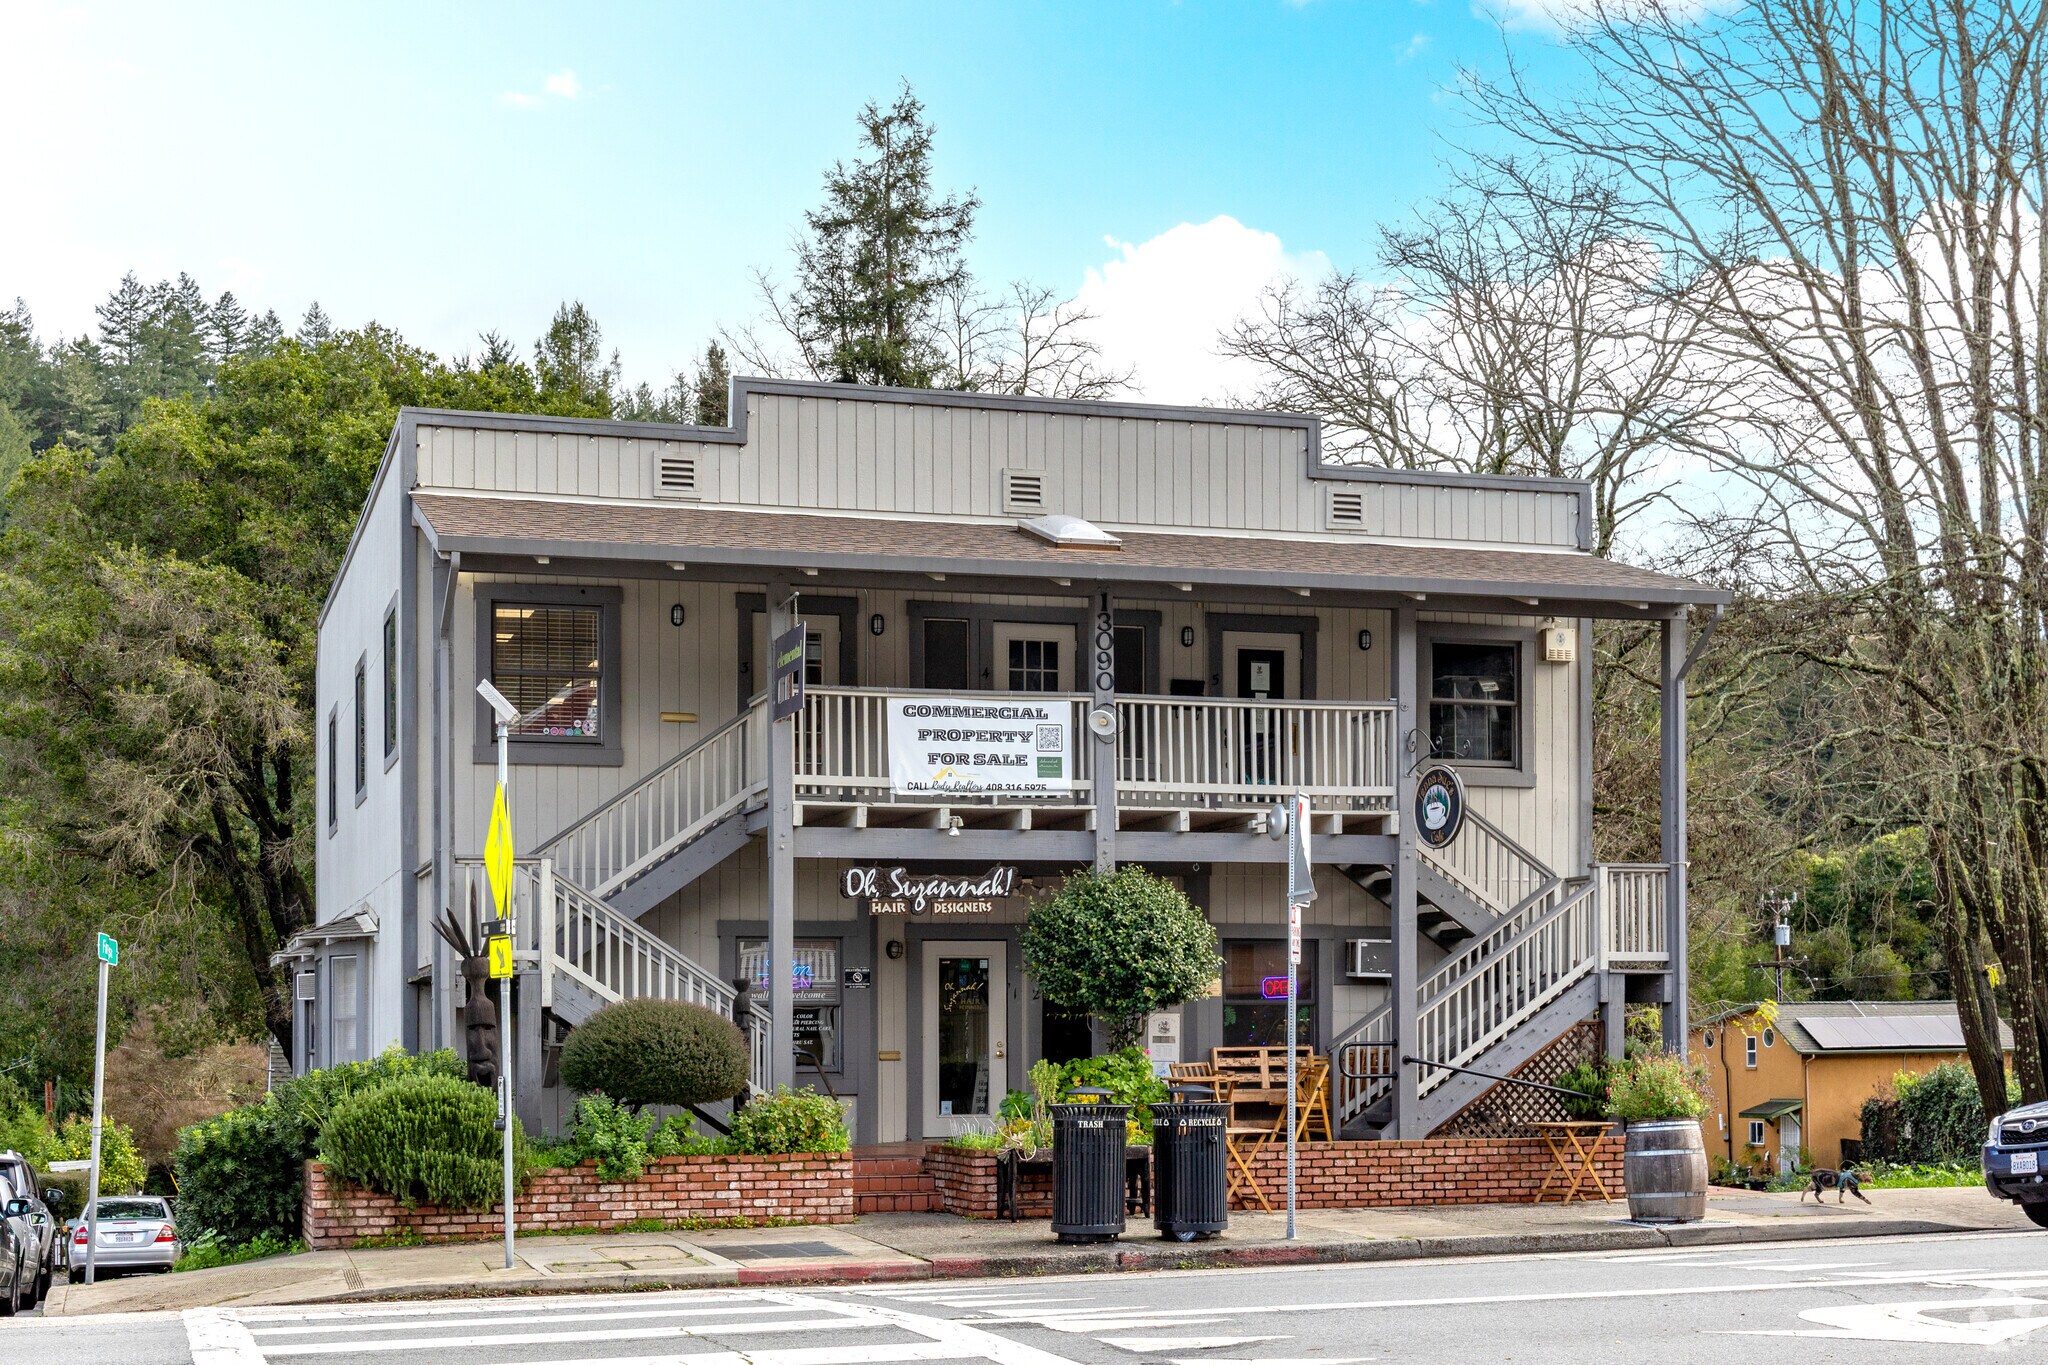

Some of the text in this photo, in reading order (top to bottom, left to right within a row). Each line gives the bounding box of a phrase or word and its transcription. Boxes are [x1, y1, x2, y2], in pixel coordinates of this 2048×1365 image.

[1095, 592, 1114, 691] 13090
[777, 639, 802, 669] elemental
[740, 661, 749, 674] 3
[981, 666, 990, 680] 4
[1211, 673, 1219, 686] 5
[902, 704, 1048, 720] COMMERCIAL
[917, 728, 1033, 743] PROPERTY
[927, 752, 970, 766] FOR
[973, 753, 1028, 767] SALE
[907, 780, 929, 791] CALL
[986, 783, 1047, 791] 408.316.5975
[846, 867, 1013, 911] Oh, Suzannah!
[871, 901, 992, 914] HAIR DESIGNERS
[761, 977, 812, 990] OEN
[1264, 980, 1288, 996] OPE
[1077, 1120, 1104, 1129] TRASH
[1188, 1118, 1217, 1127] RECYCLE
